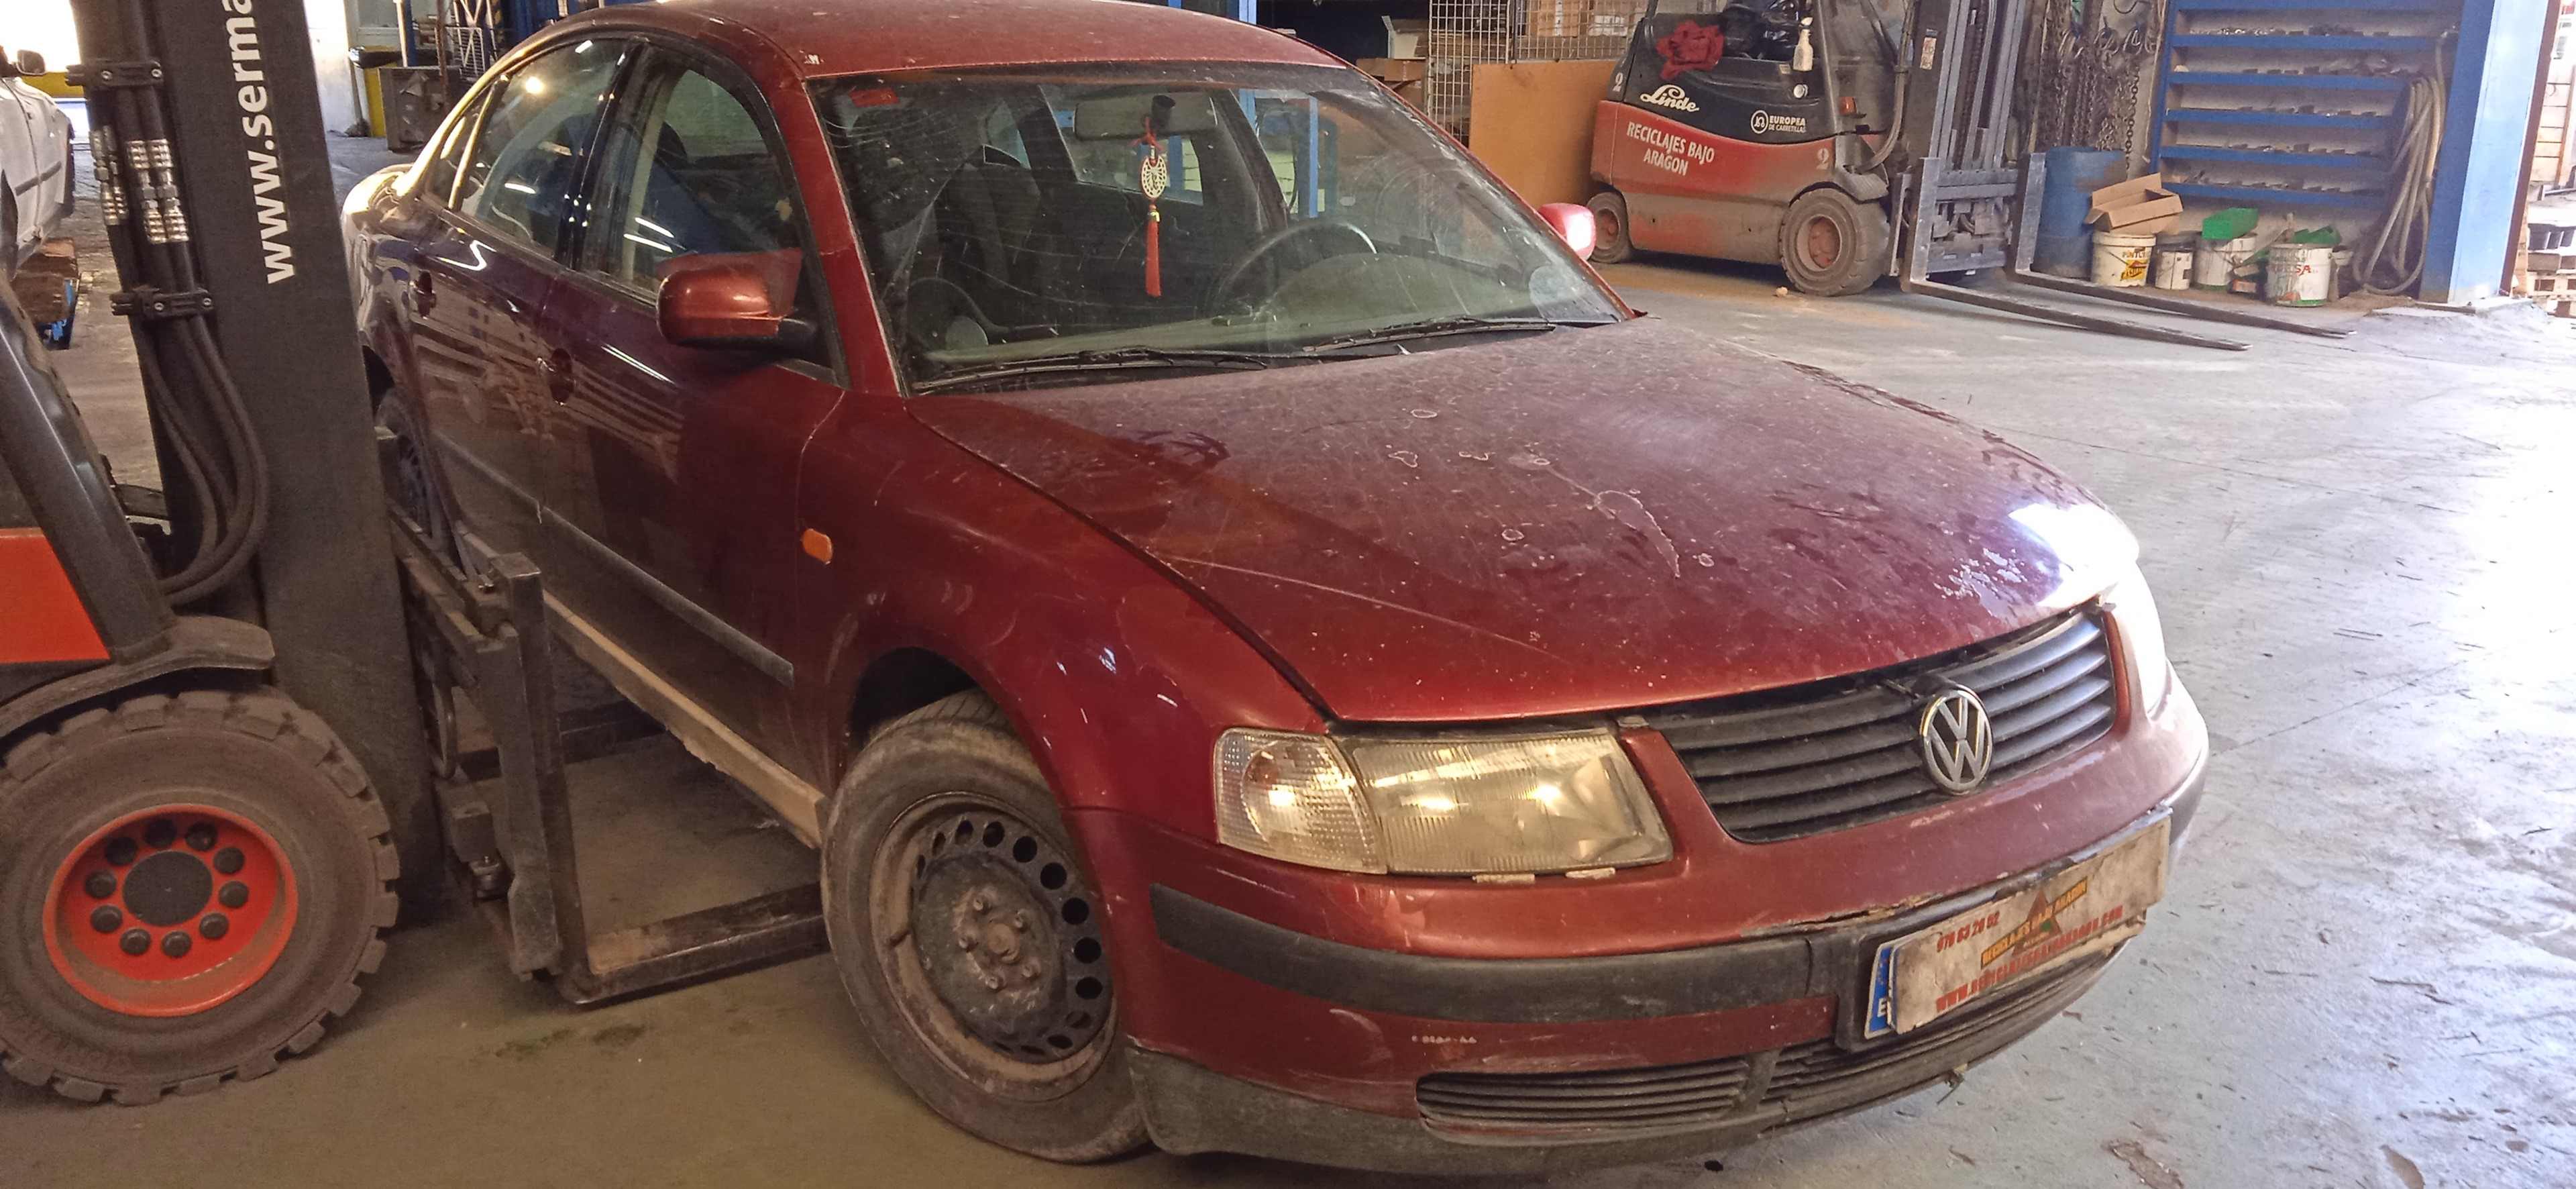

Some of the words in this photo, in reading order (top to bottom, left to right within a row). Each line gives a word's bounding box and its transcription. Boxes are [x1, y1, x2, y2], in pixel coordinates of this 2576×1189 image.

[1613, 72, 1623, 93] 2
[1640, 85, 1700, 112] Linde
[1769, 115, 1806, 127] EUROPEA
[1776, 124, 1807, 133] CARRETILLAS
[1627, 121, 1687, 154] RECICLAJES
[1687, 141, 1715, 165] BAJO
[1644, 148, 1689, 176] ARAGON
[1816, 148, 1829, 170] 2
[1877, 998, 1888, 1017] E
